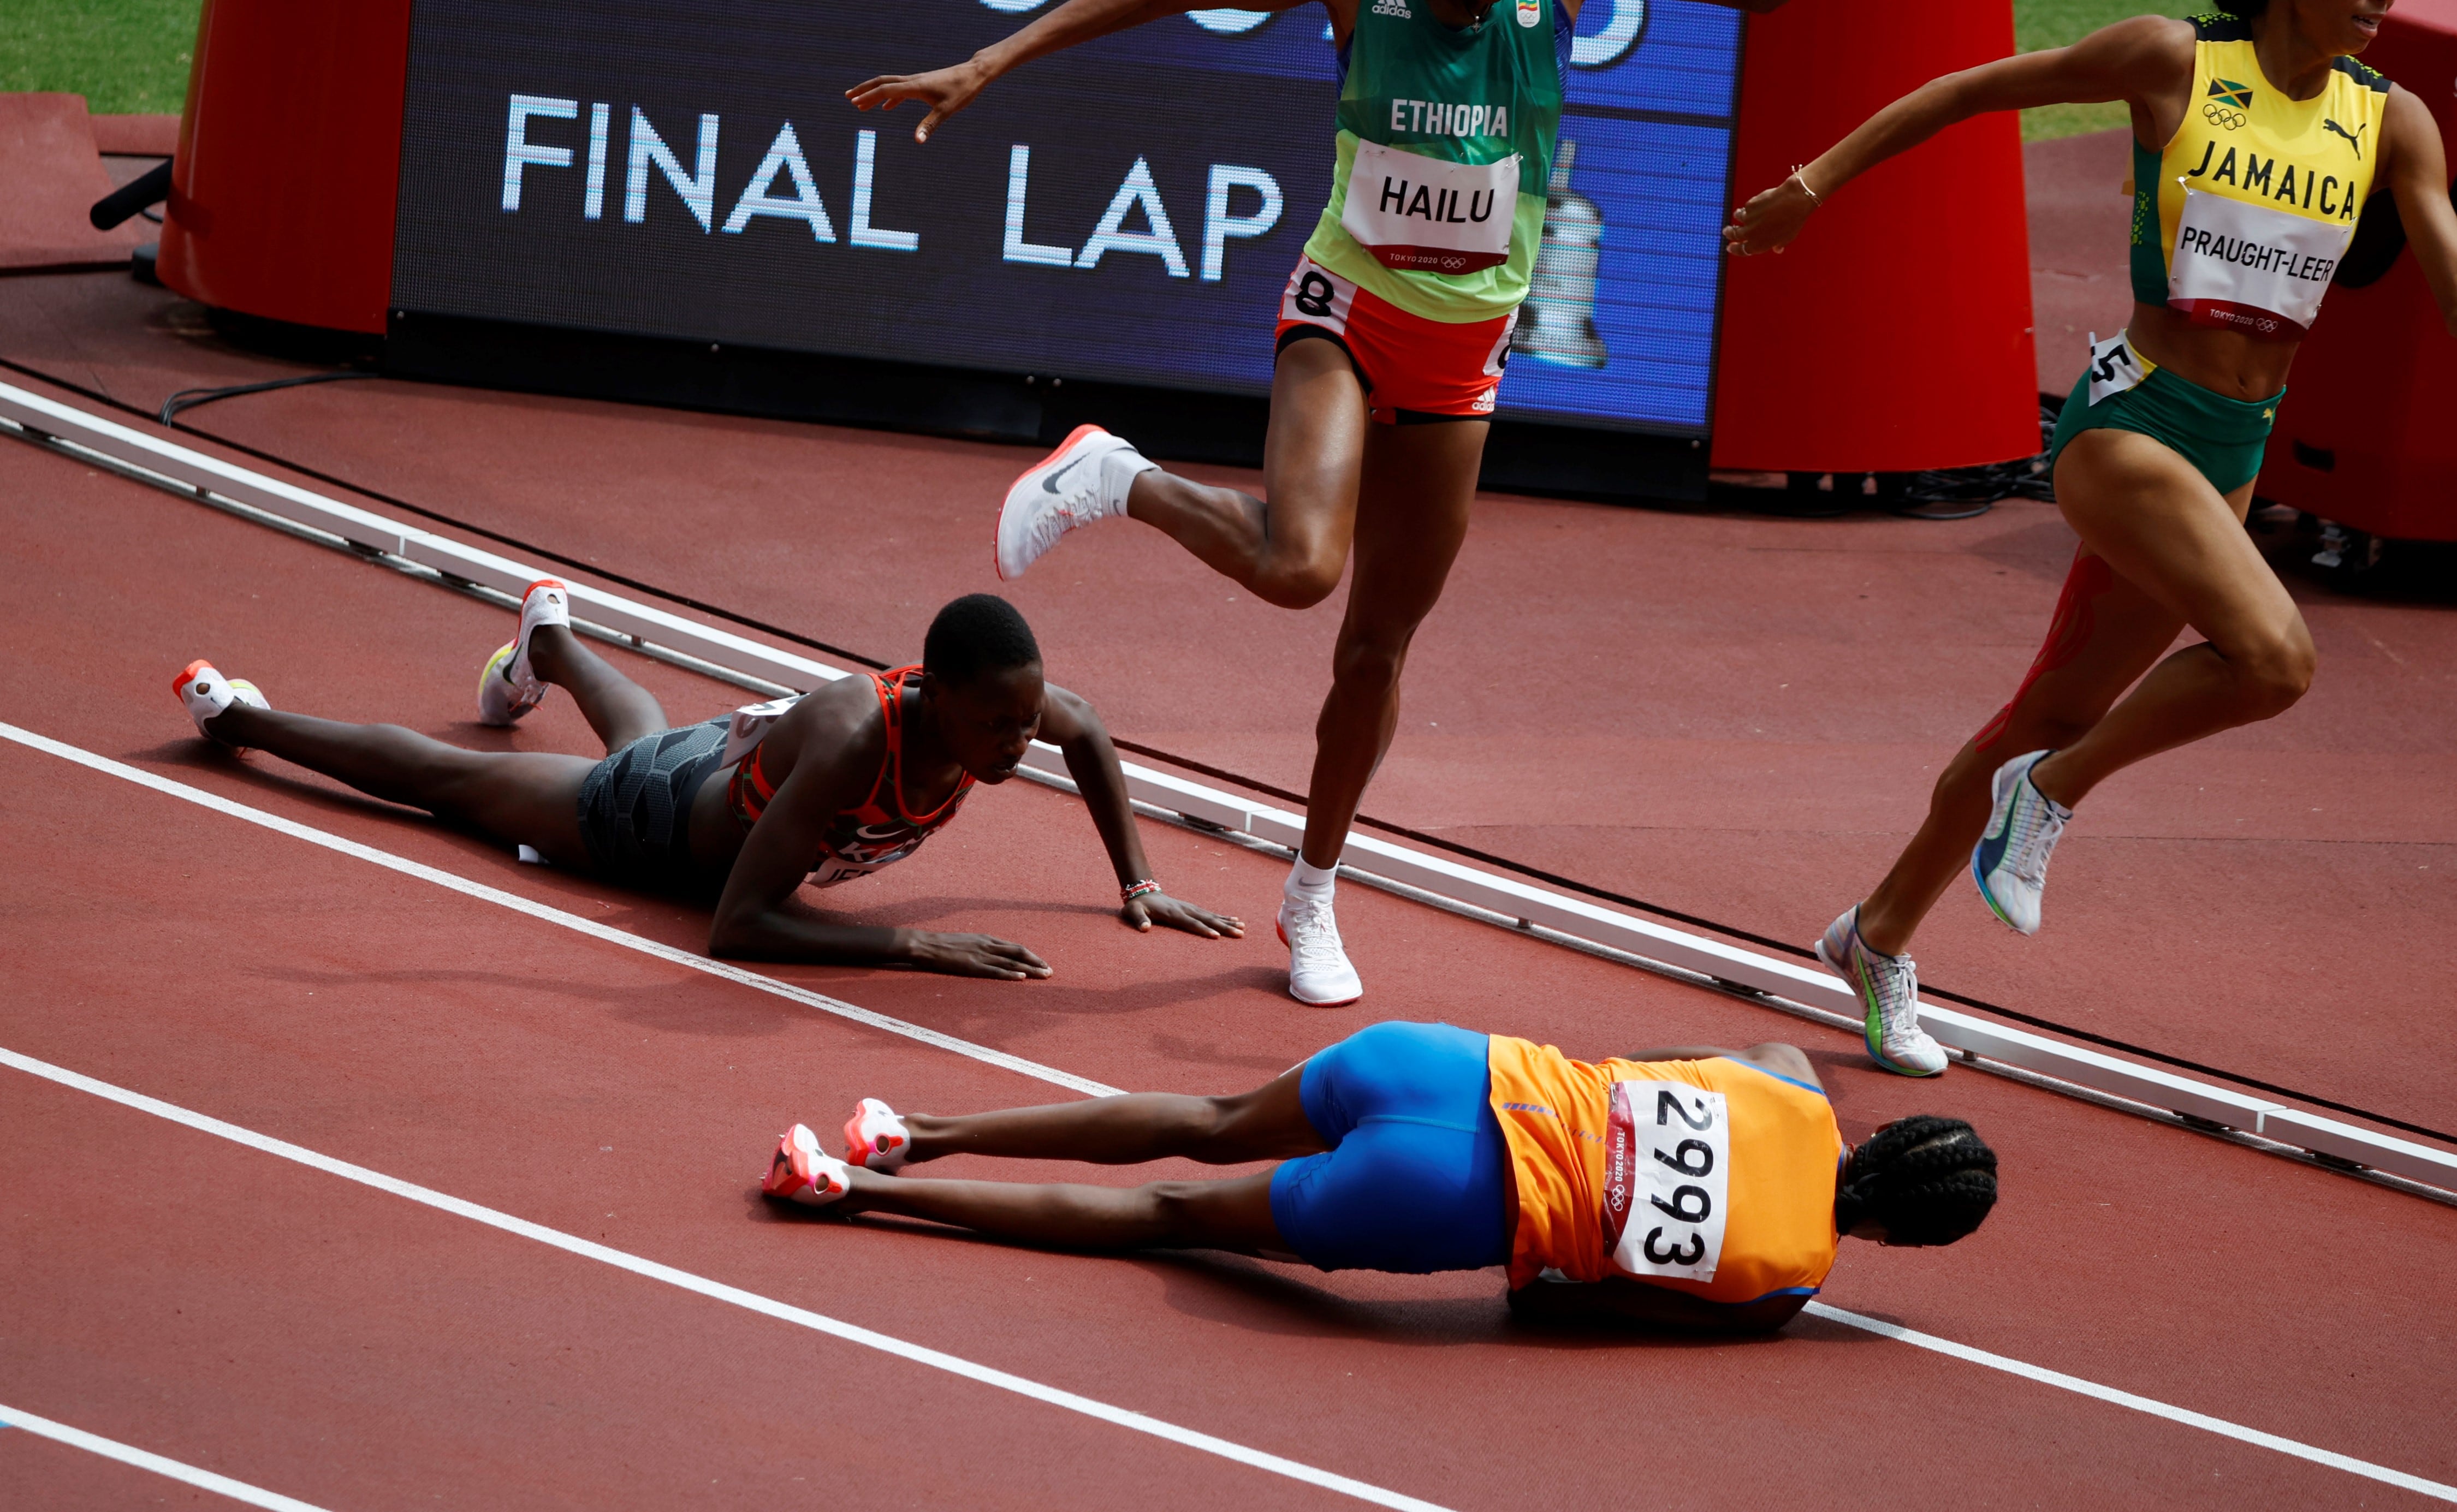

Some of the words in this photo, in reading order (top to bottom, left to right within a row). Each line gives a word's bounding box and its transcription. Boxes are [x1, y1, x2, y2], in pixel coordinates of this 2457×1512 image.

[1372, 3, 1411, 19] adidas
[1391, 98, 1508, 137] ETHIOPIA
[502, 93, 919, 252] FINAL
[1002, 144, 1284, 282] LAP
[1379, 176, 1495, 223] HAILU
[2187, 140, 2354, 221] JAMAICA
[1390, 253, 1417, 263] TOKYO
[1417, 255, 1438, 264] 2020
[2181, 226, 2334, 282] PRAUGHT-LEER
[1295, 270, 1334, 317] 8
[2210, 308, 2236, 322] TOKYO
[2234, 315, 2254, 325] 2020
[2090, 343, 2132, 383] 5
[1616, 1132, 1625, 1160] TOKYO
[1615, 1160, 1624, 1182] 2020
[1643, 1090, 1714, 1266] 2993
